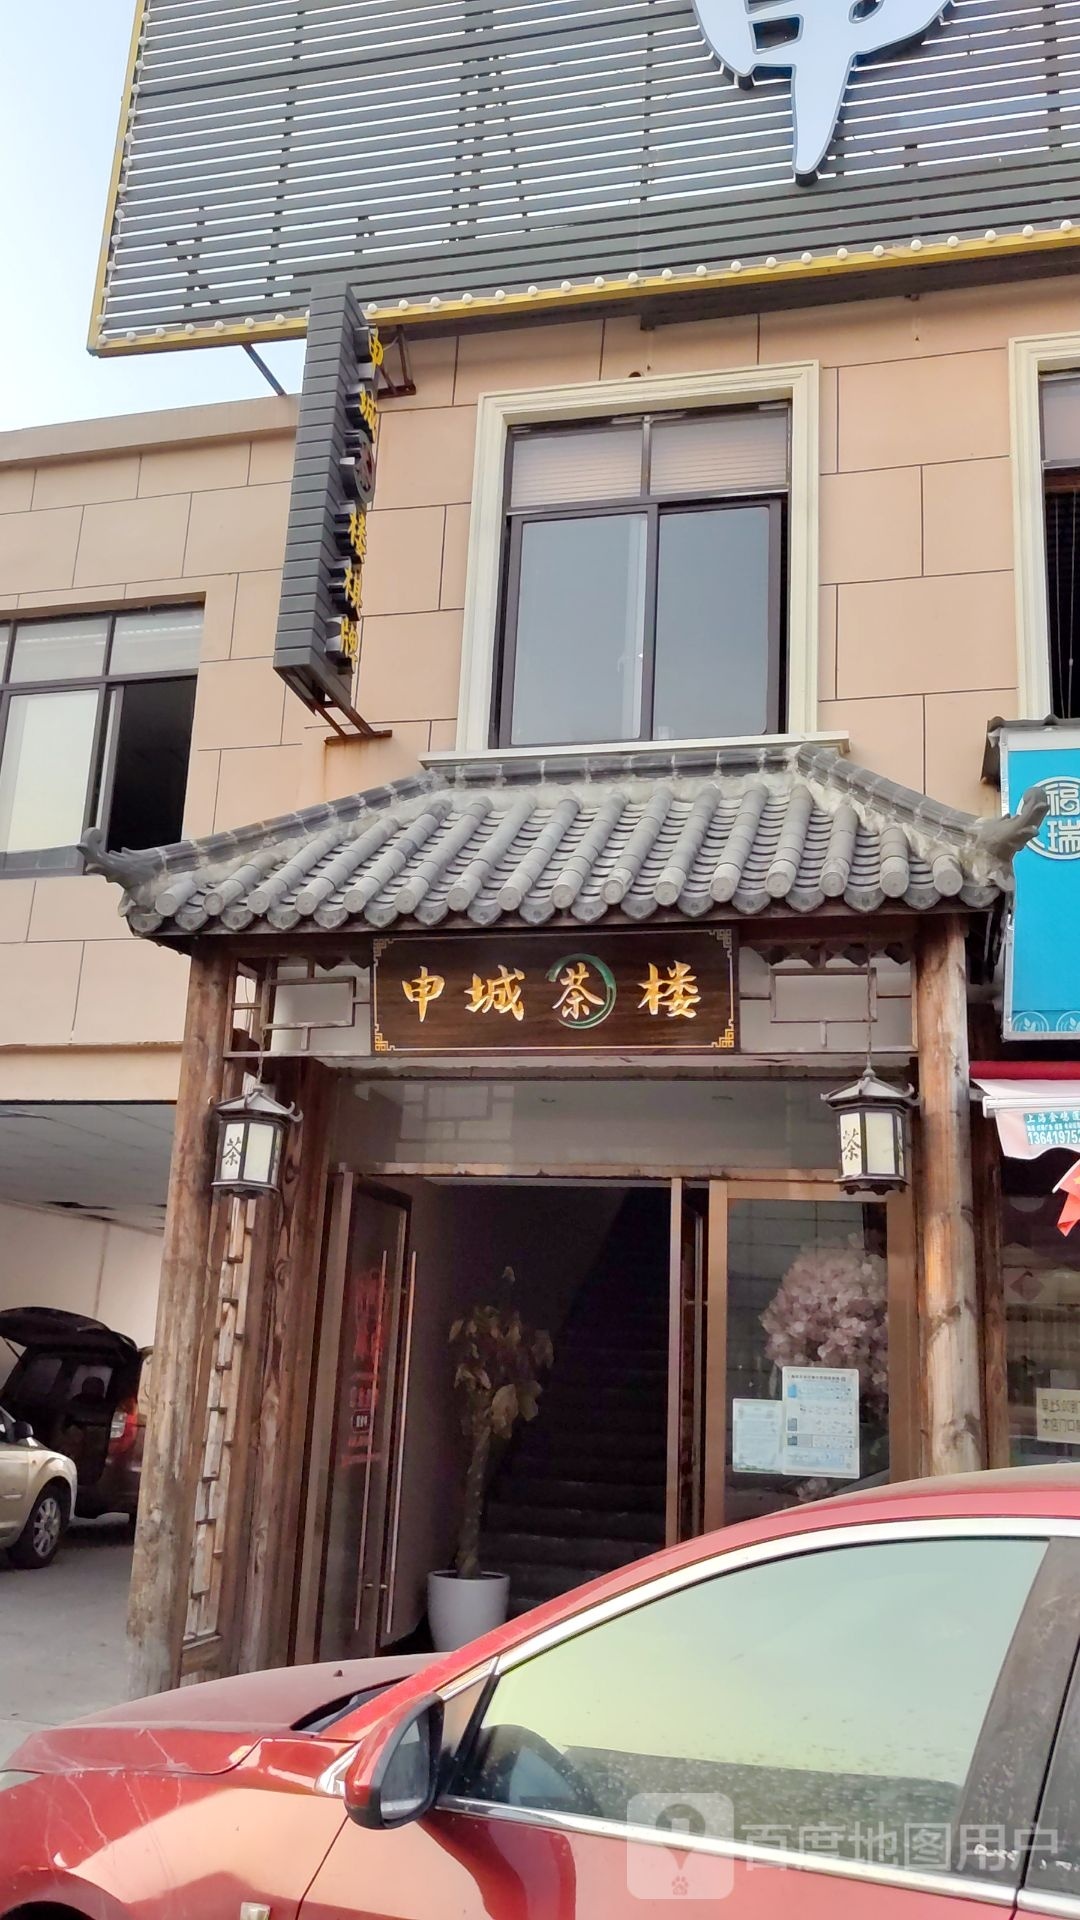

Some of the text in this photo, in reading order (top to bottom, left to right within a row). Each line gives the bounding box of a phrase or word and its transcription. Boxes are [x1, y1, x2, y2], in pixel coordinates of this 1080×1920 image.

[402, 960, 702, 1022] 申城茶楼
[222, 1136, 242, 1166] 茶
[841, 1128, 861, 1161] 茶
